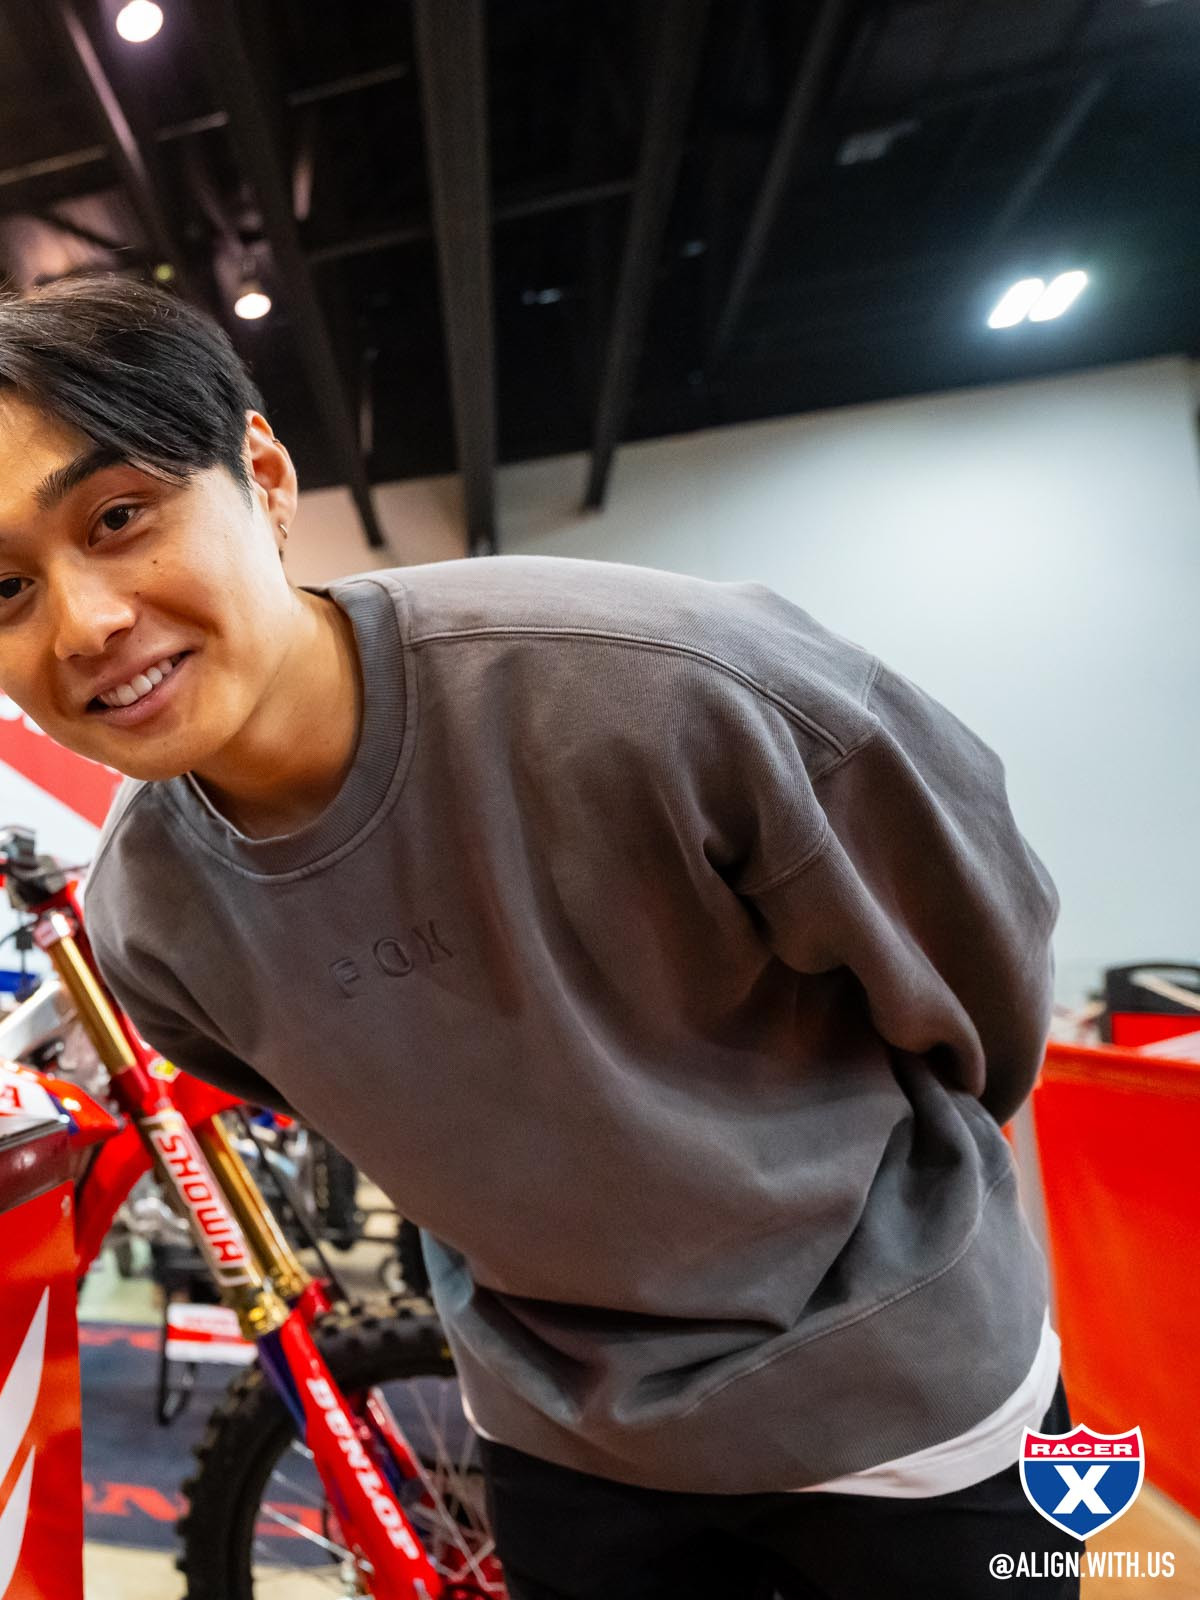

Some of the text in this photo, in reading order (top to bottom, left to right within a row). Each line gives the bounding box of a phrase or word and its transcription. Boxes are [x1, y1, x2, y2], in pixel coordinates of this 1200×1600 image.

[328, 920, 453, 998] FOX
[158, 1135, 244, 1262] SHOWA
[305, 1377, 420, 1560] DUNLOP
